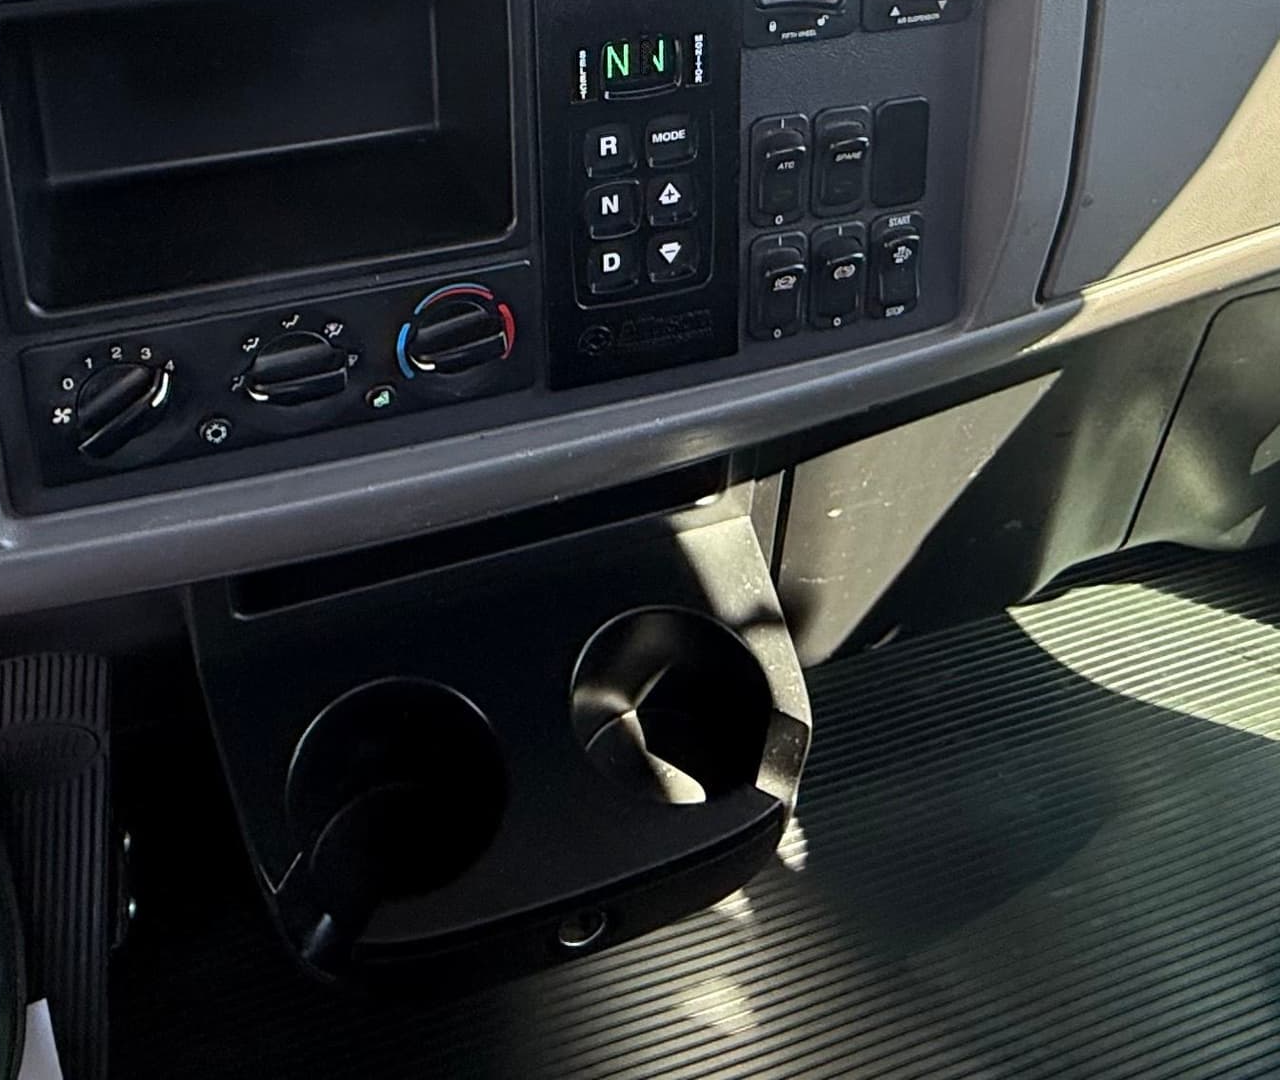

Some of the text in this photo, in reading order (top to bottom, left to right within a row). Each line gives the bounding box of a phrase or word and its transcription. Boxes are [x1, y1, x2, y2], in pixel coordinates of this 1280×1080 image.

[798, 29, 817, 38] WHEEL
[607, 43, 629, 79] N
[694, 33, 704, 83] MONITOR
[579, 49, 588, 100] SELECT
[651, 129, 686, 144] MODE
[600, 135, 618, 157] R
[601, 194, 620, 215] N
[888, 214, 911, 228] START
[602, 252, 621, 273] D
[885, 305, 905, 318] STOP
[111, 346, 123, 359] 2
[140, 347, 152, 360] 3
[84, 357, 93, 369] 1
[165, 360, 175, 371] 4
